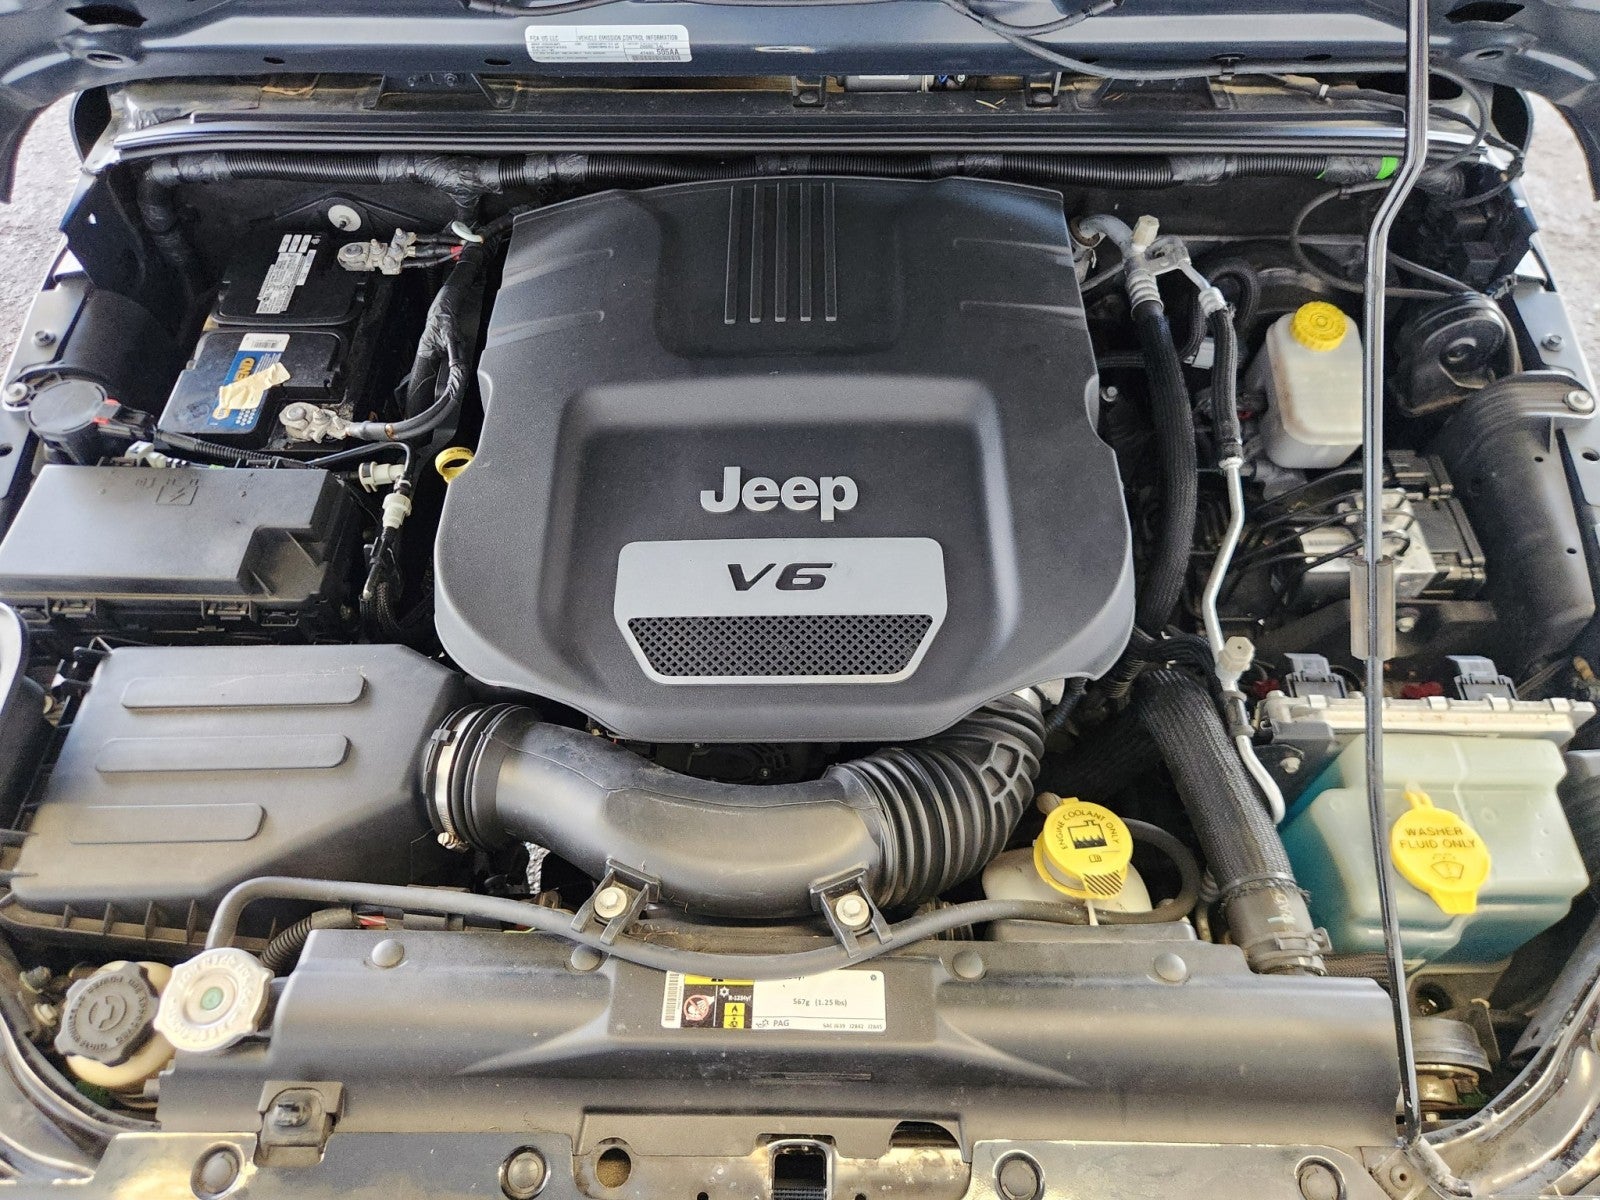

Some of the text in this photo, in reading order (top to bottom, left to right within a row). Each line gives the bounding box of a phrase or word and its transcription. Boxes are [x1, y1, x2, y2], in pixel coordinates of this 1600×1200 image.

[700, 466, 859, 523] Jeep
[727, 562, 834, 592] V6
[1056, 809, 1121, 850] ENGINE COOLANT ONLY
[1405, 827, 1464, 836] WASHER
[1400, 840, 1476, 849] FLUID ONLY
[793, 997, 848, 1008] 567g (1.25 lbs)
[773, 1019, 790, 1027] PAG
